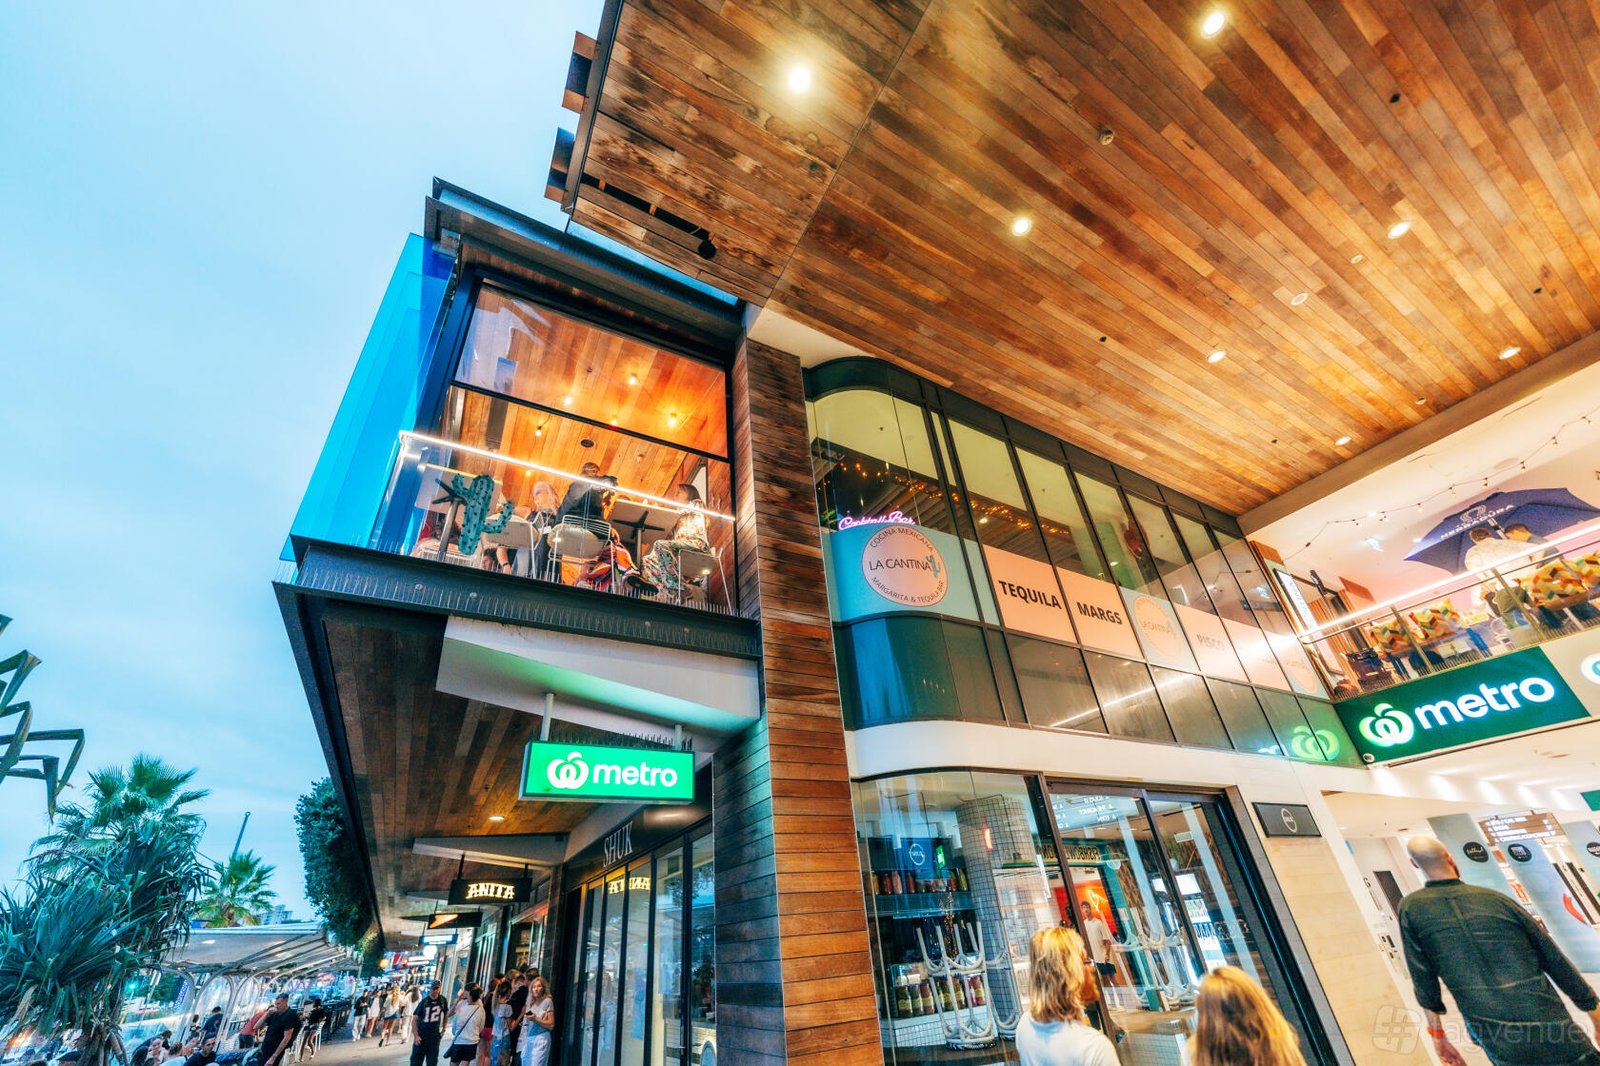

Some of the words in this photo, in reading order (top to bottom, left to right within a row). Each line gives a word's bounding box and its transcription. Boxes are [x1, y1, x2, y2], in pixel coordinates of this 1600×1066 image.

[887, 510, 916, 525] Bar
[869, 527, 897, 548] COCINA
[898, 527, 934, 552] MEXICANA
[869, 560, 884, 571] LA
[885, 558, 932, 571] CANTINA
[872, 577, 909, 602] MARGARITA
[998, 580, 1062, 609] TEQUILA
[1076, 601, 1122, 624] MARGS
[1414, 677, 1555, 730] metro
[593, 762, 678, 787] metro
[603, 821, 633, 868] SHUK
[465, 883, 515, 900] ANITA
[423, 1005, 440, 1022] 12
